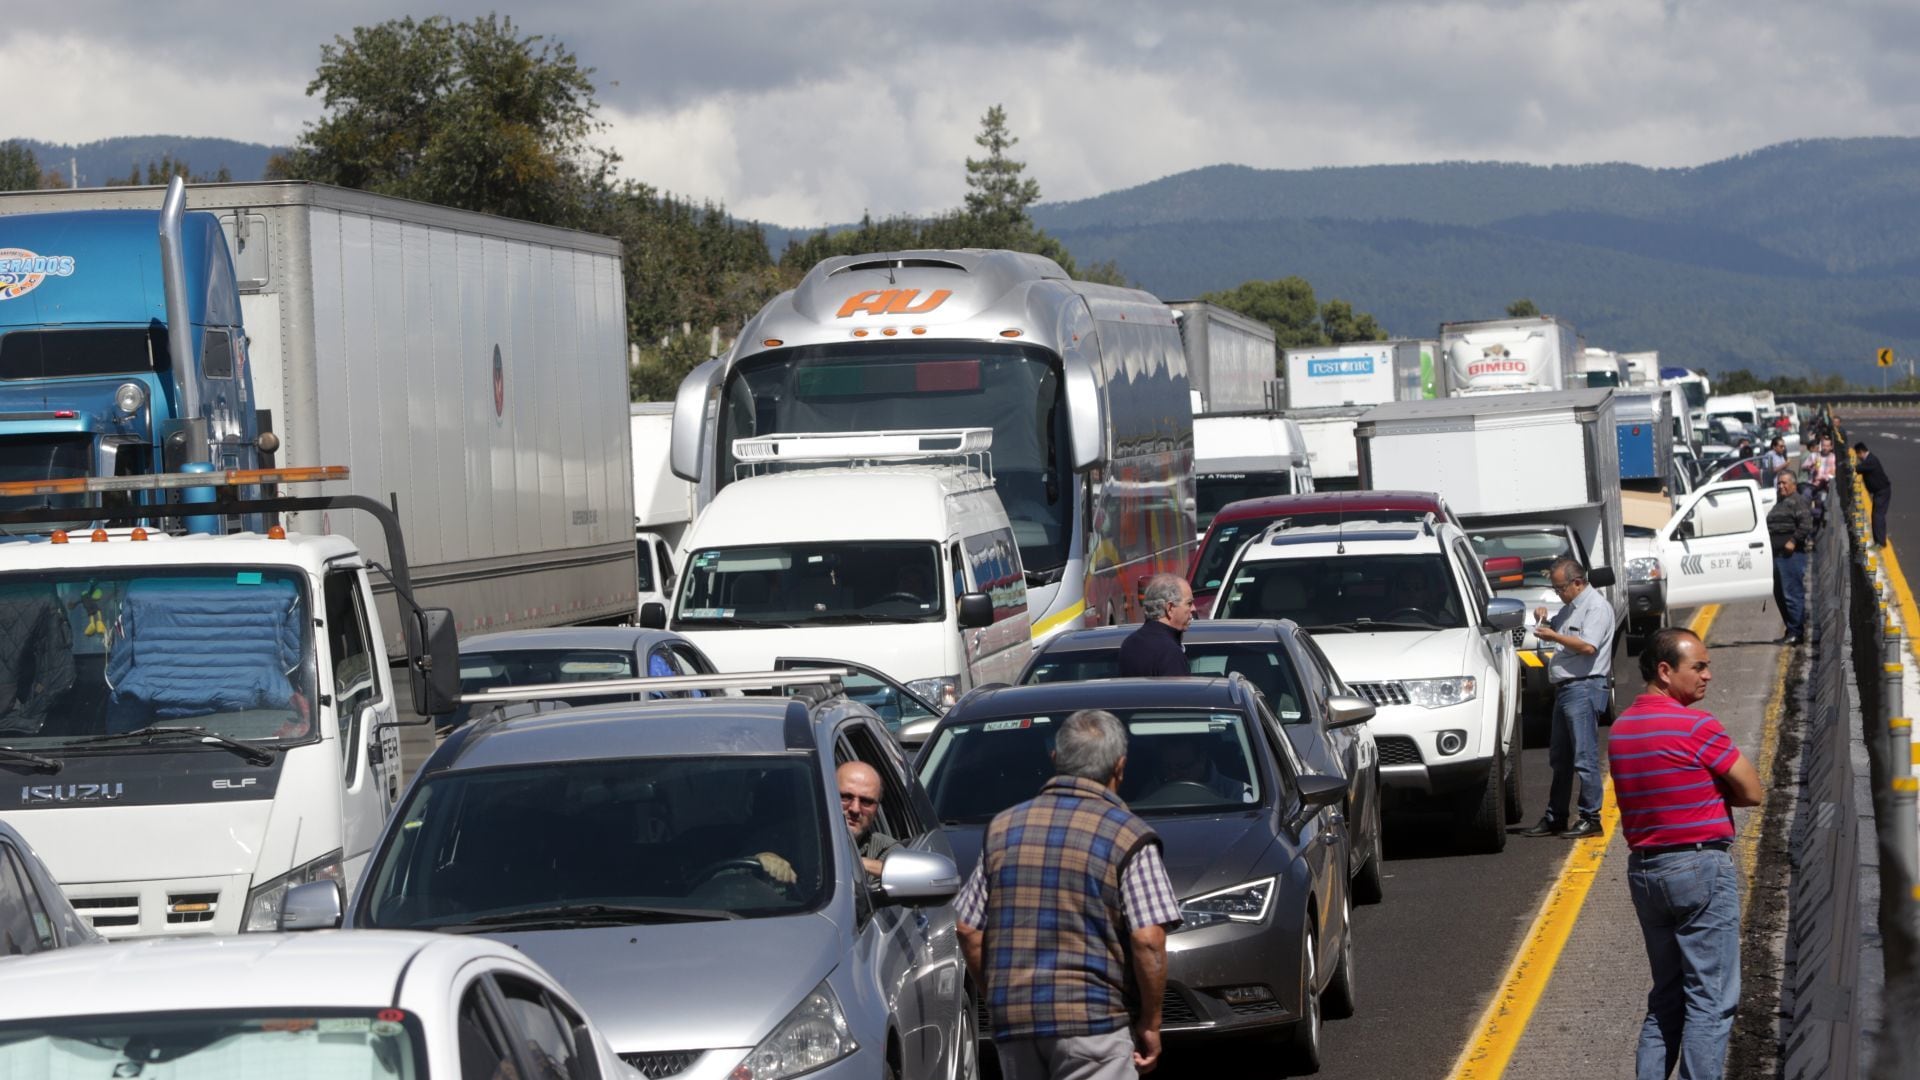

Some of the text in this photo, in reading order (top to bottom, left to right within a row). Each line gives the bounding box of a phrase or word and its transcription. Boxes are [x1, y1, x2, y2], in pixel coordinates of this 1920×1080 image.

[1468, 361, 1526, 376] BIMBO
[212, 777, 257, 790] ELF
[21, 782, 123, 804] ISUZU
